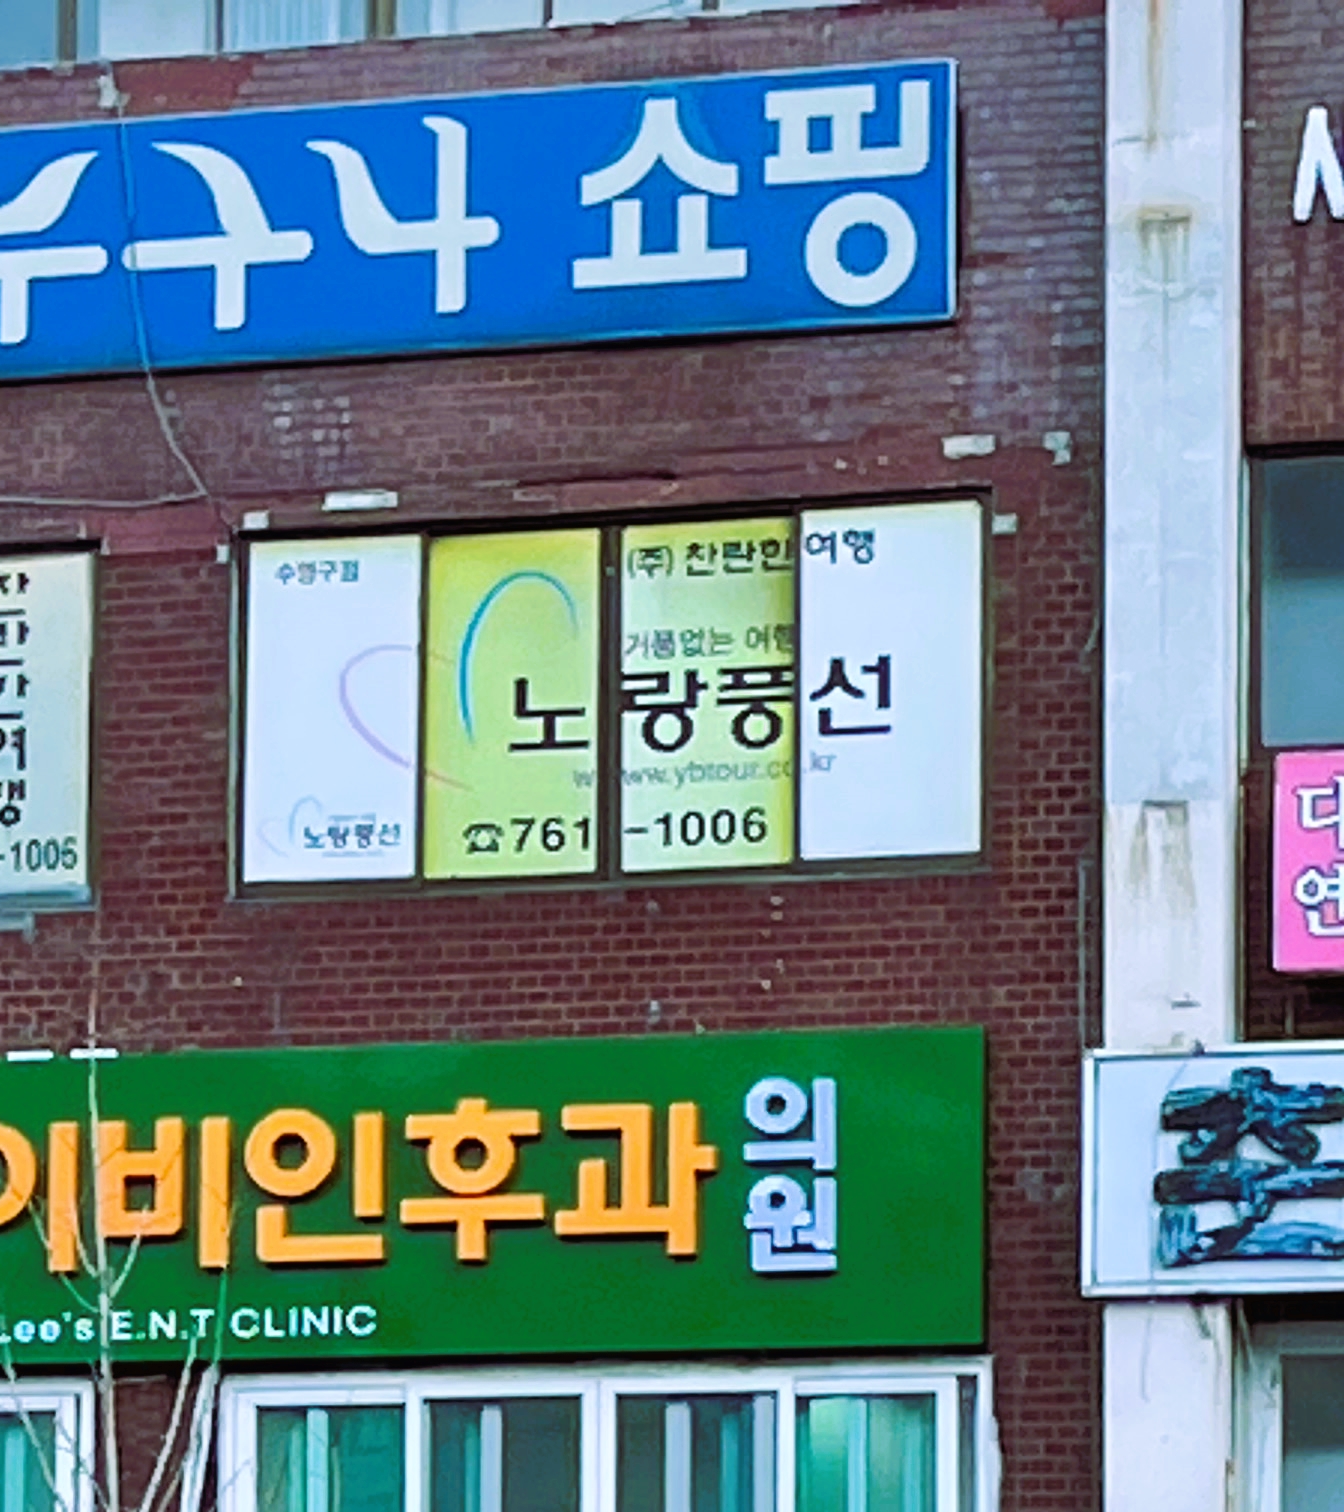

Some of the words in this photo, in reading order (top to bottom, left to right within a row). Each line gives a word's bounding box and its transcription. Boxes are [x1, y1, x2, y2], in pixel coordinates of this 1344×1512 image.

[571, 80, 933, 307] 쇼핑
[627, 544, 673, 580] (주)
[683, 537, 794, 576] 찬란한
[803, 527, 877, 566] 여행
[508, 653, 893, 753] 노랑풍선
[302, 820, 402, 850] 노랑풍선
[511, 806, 769, 855] 761-1006
[743, 1073, 840, 1274] 의원
[230, 1305, 378, 1340] CLINIC
